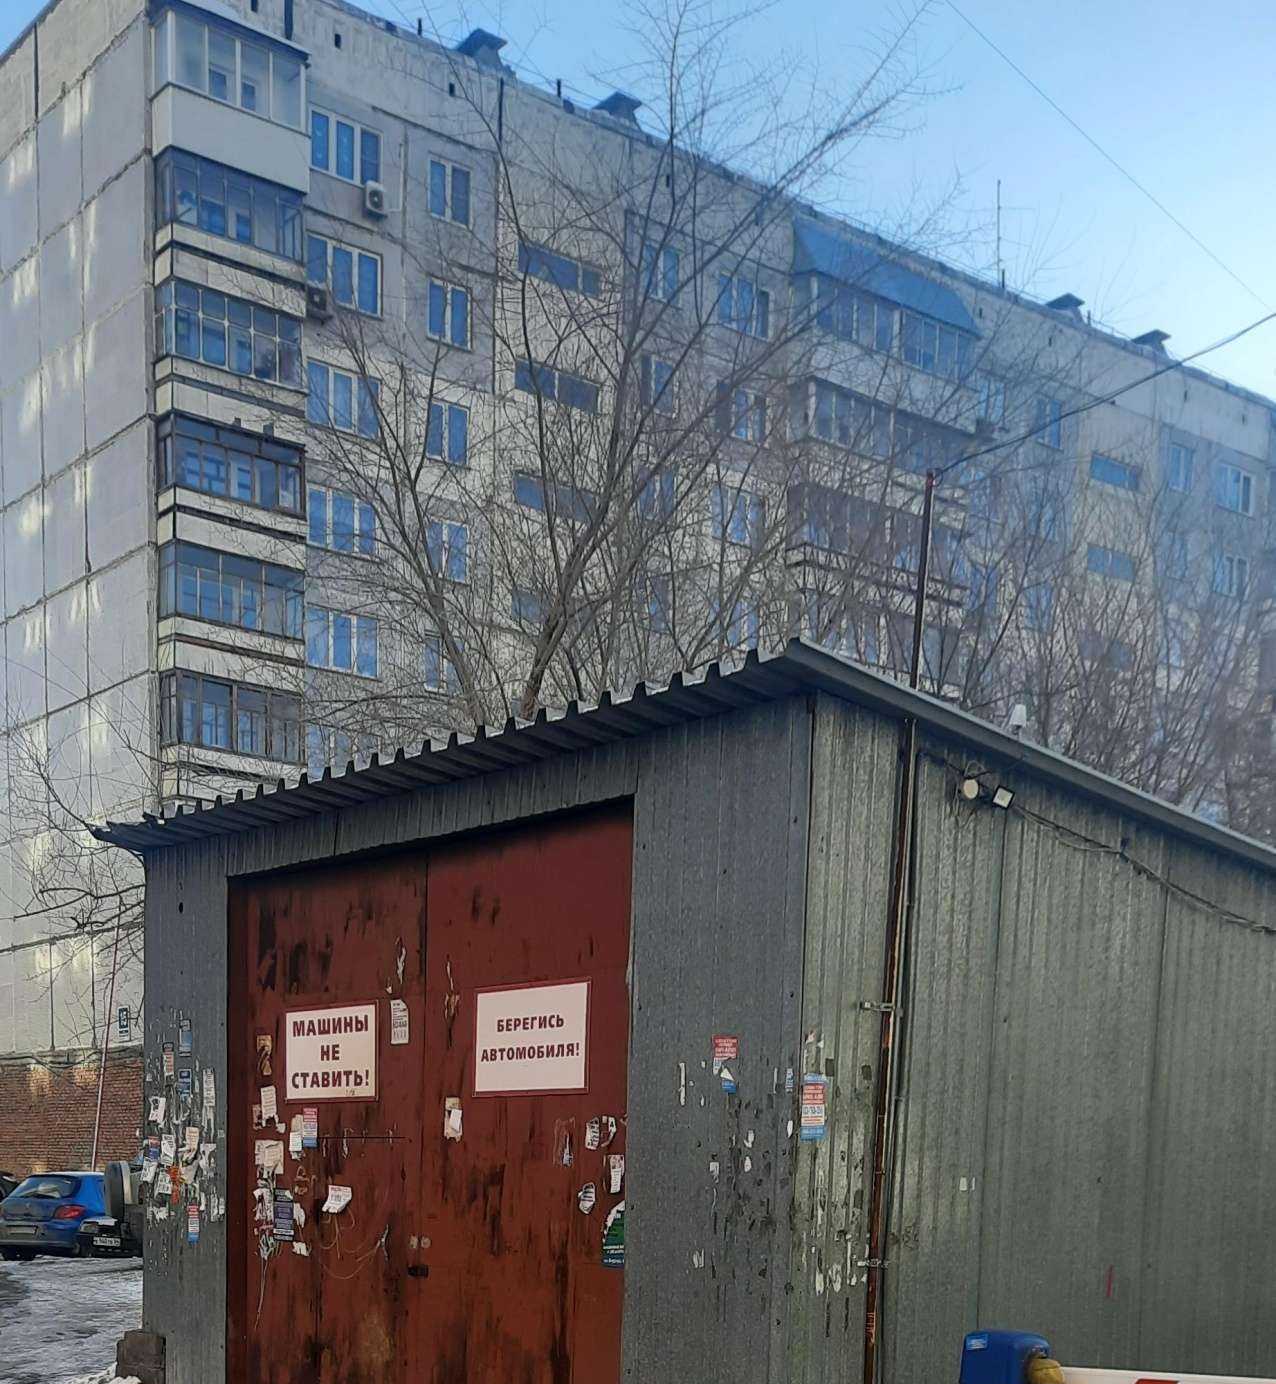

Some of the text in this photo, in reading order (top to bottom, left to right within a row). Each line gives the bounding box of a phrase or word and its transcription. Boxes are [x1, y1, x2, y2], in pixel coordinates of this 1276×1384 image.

[292, 1014, 369, 1037] МАШИНЫ
[496, 1014, 564, 1032] БЕРЕГИСЬ
[320, 1044, 340, 1061] НЕ
[480, 1042, 580, 1062] АВТОМОБИЛЯ!
[291, 1069, 370, 1089] СТАВИТЬ!
